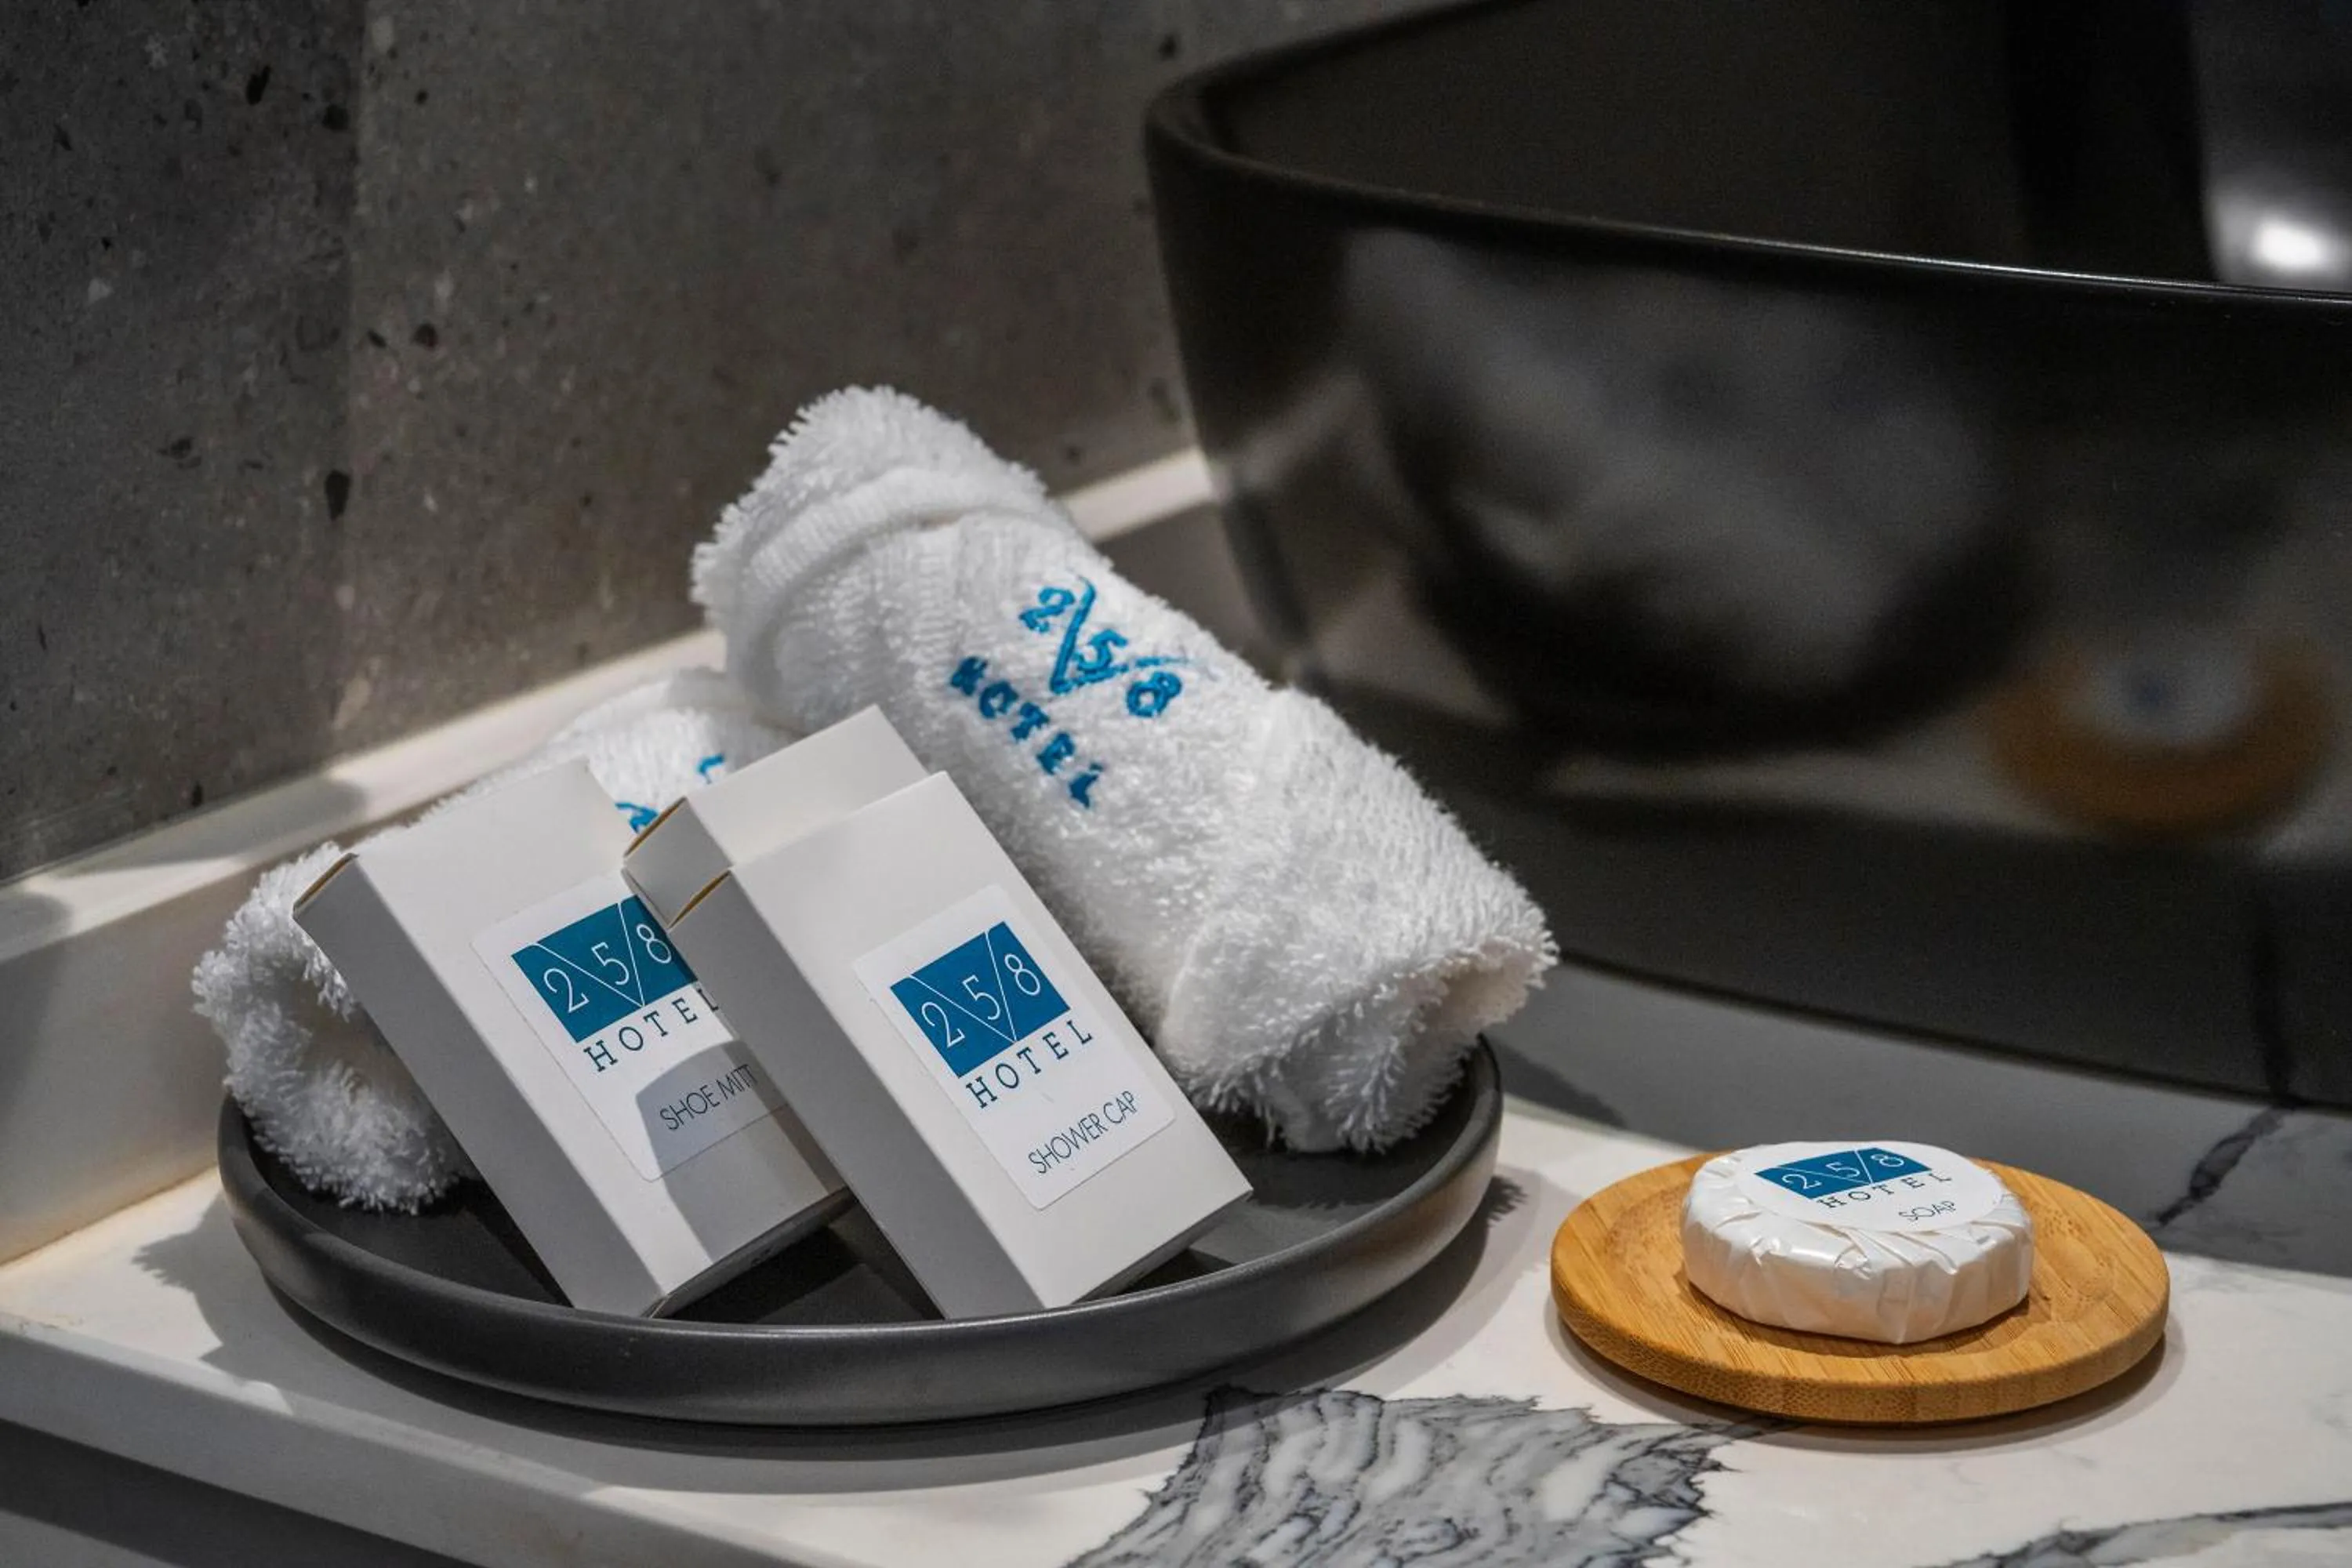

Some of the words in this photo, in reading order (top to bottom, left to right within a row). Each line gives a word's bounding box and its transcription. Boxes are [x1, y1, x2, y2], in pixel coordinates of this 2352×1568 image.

[544, 924, 672, 1013] 258
[921, 953, 1041, 1048] 258
[583, 988, 720, 1072] HOTEL
[965, 1020, 1094, 1109] HOTEL
[659, 1084, 720, 1131] SHOE
[715, 1063, 758, 1101] MITT
[1028, 1112, 1109, 1174] SHOWER
[1102, 1090, 1138, 1124] CAP
[1781, 1152, 1905, 1192] 258
[1817, 1172, 1952, 1210] HOTEL
[1898, 1200, 1957, 1222] SOAP
